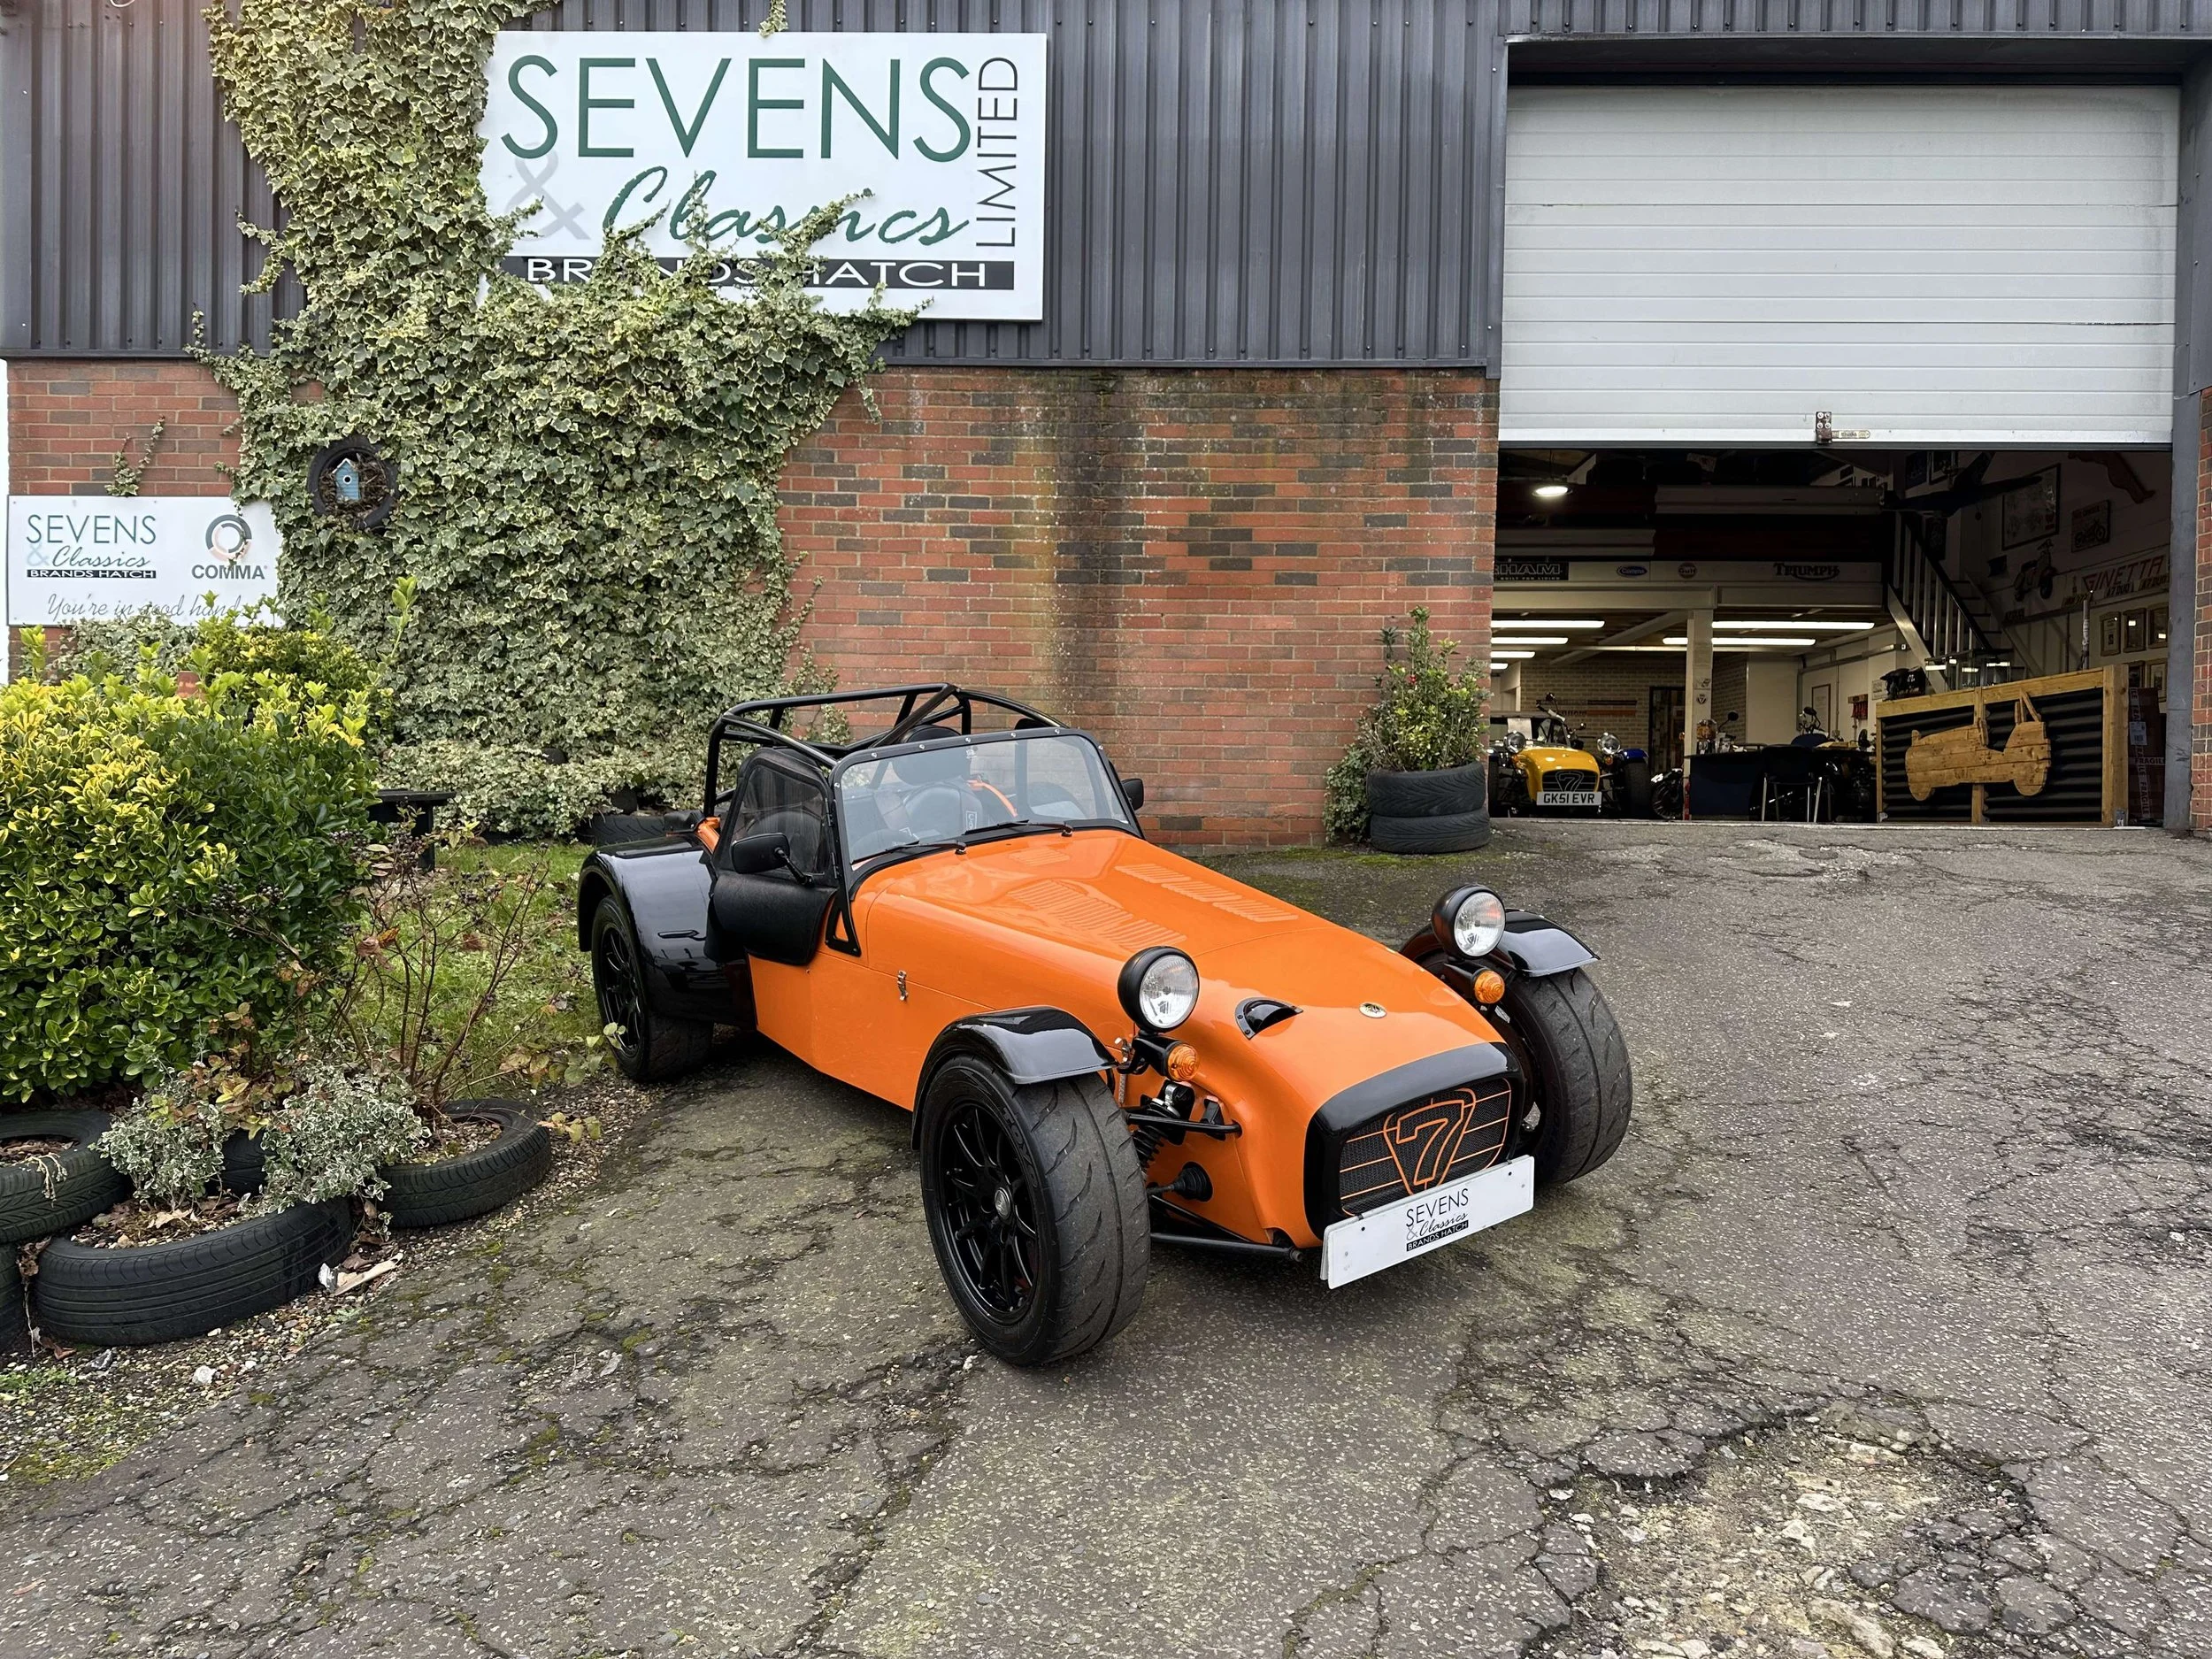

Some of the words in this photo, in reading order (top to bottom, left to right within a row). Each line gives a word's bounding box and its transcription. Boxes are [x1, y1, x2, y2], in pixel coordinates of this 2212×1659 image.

[500, 54, 972, 163] SEVENS
[976, 57, 1018, 248] LIMITED
[26, 514, 157, 544] SEVENS
[27, 541, 50, 566] &
[52, 545, 150, 567] Classics
[1773, 562, 1840, 580] TRIUMPH
[48, 593, 109, 622] You're
[1543, 793, 1569, 803] GK51
[1572, 793, 1595, 803] EVR
[1003, 1106, 1039, 1188] TOYO
[1395, 1099, 1465, 1186] 7
[1406, 1187, 1469, 1227] SEVENS
[1406, 1225, 1418, 1240] &
[1419, 1213, 1469, 1237] Classics
[1408, 1232, 1440, 1250] BRANDS
[1440, 1223, 1467, 1237] HATCH
